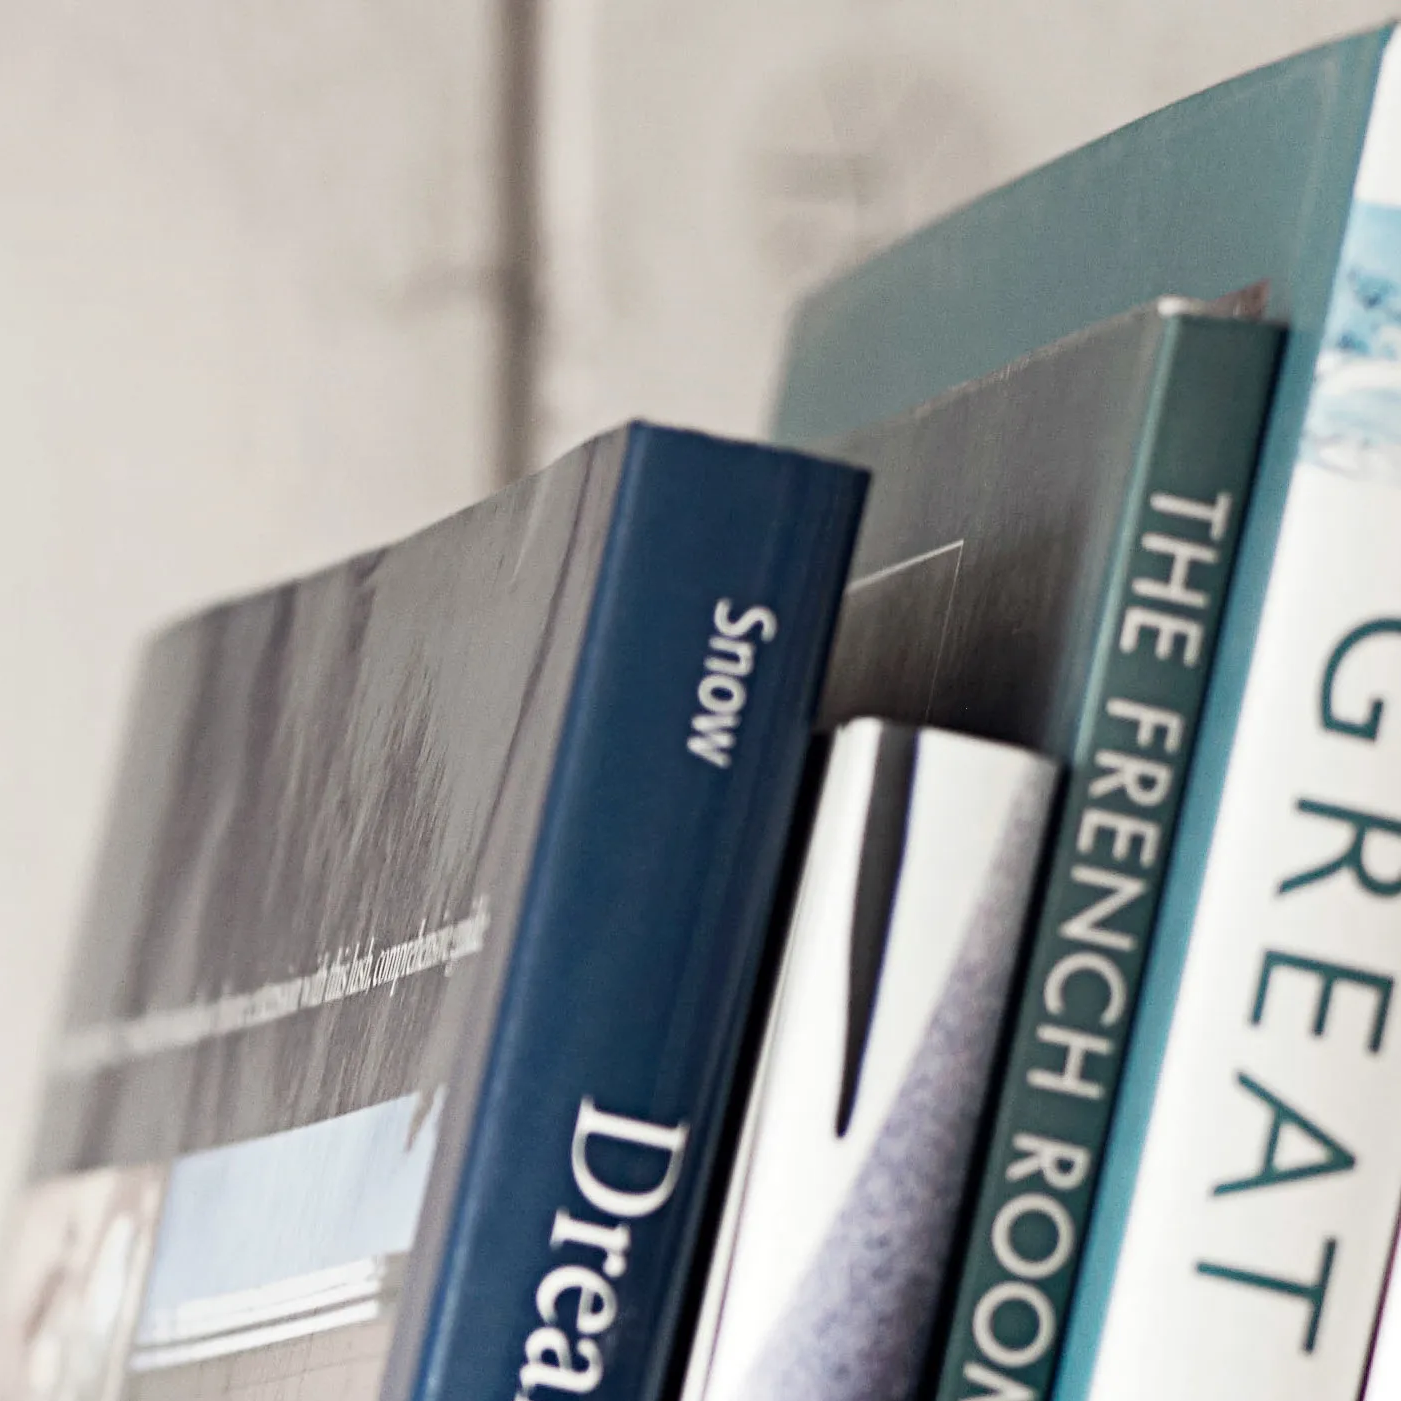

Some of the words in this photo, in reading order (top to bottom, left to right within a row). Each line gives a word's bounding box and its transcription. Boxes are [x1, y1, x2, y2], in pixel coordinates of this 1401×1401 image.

[687, 599, 777, 768] Snow
[1119, 491, 1232, 667] THE
[1027, 697, 1184, 1100] FRENCH
[1195, 616, 1401, 1355] GREAT
